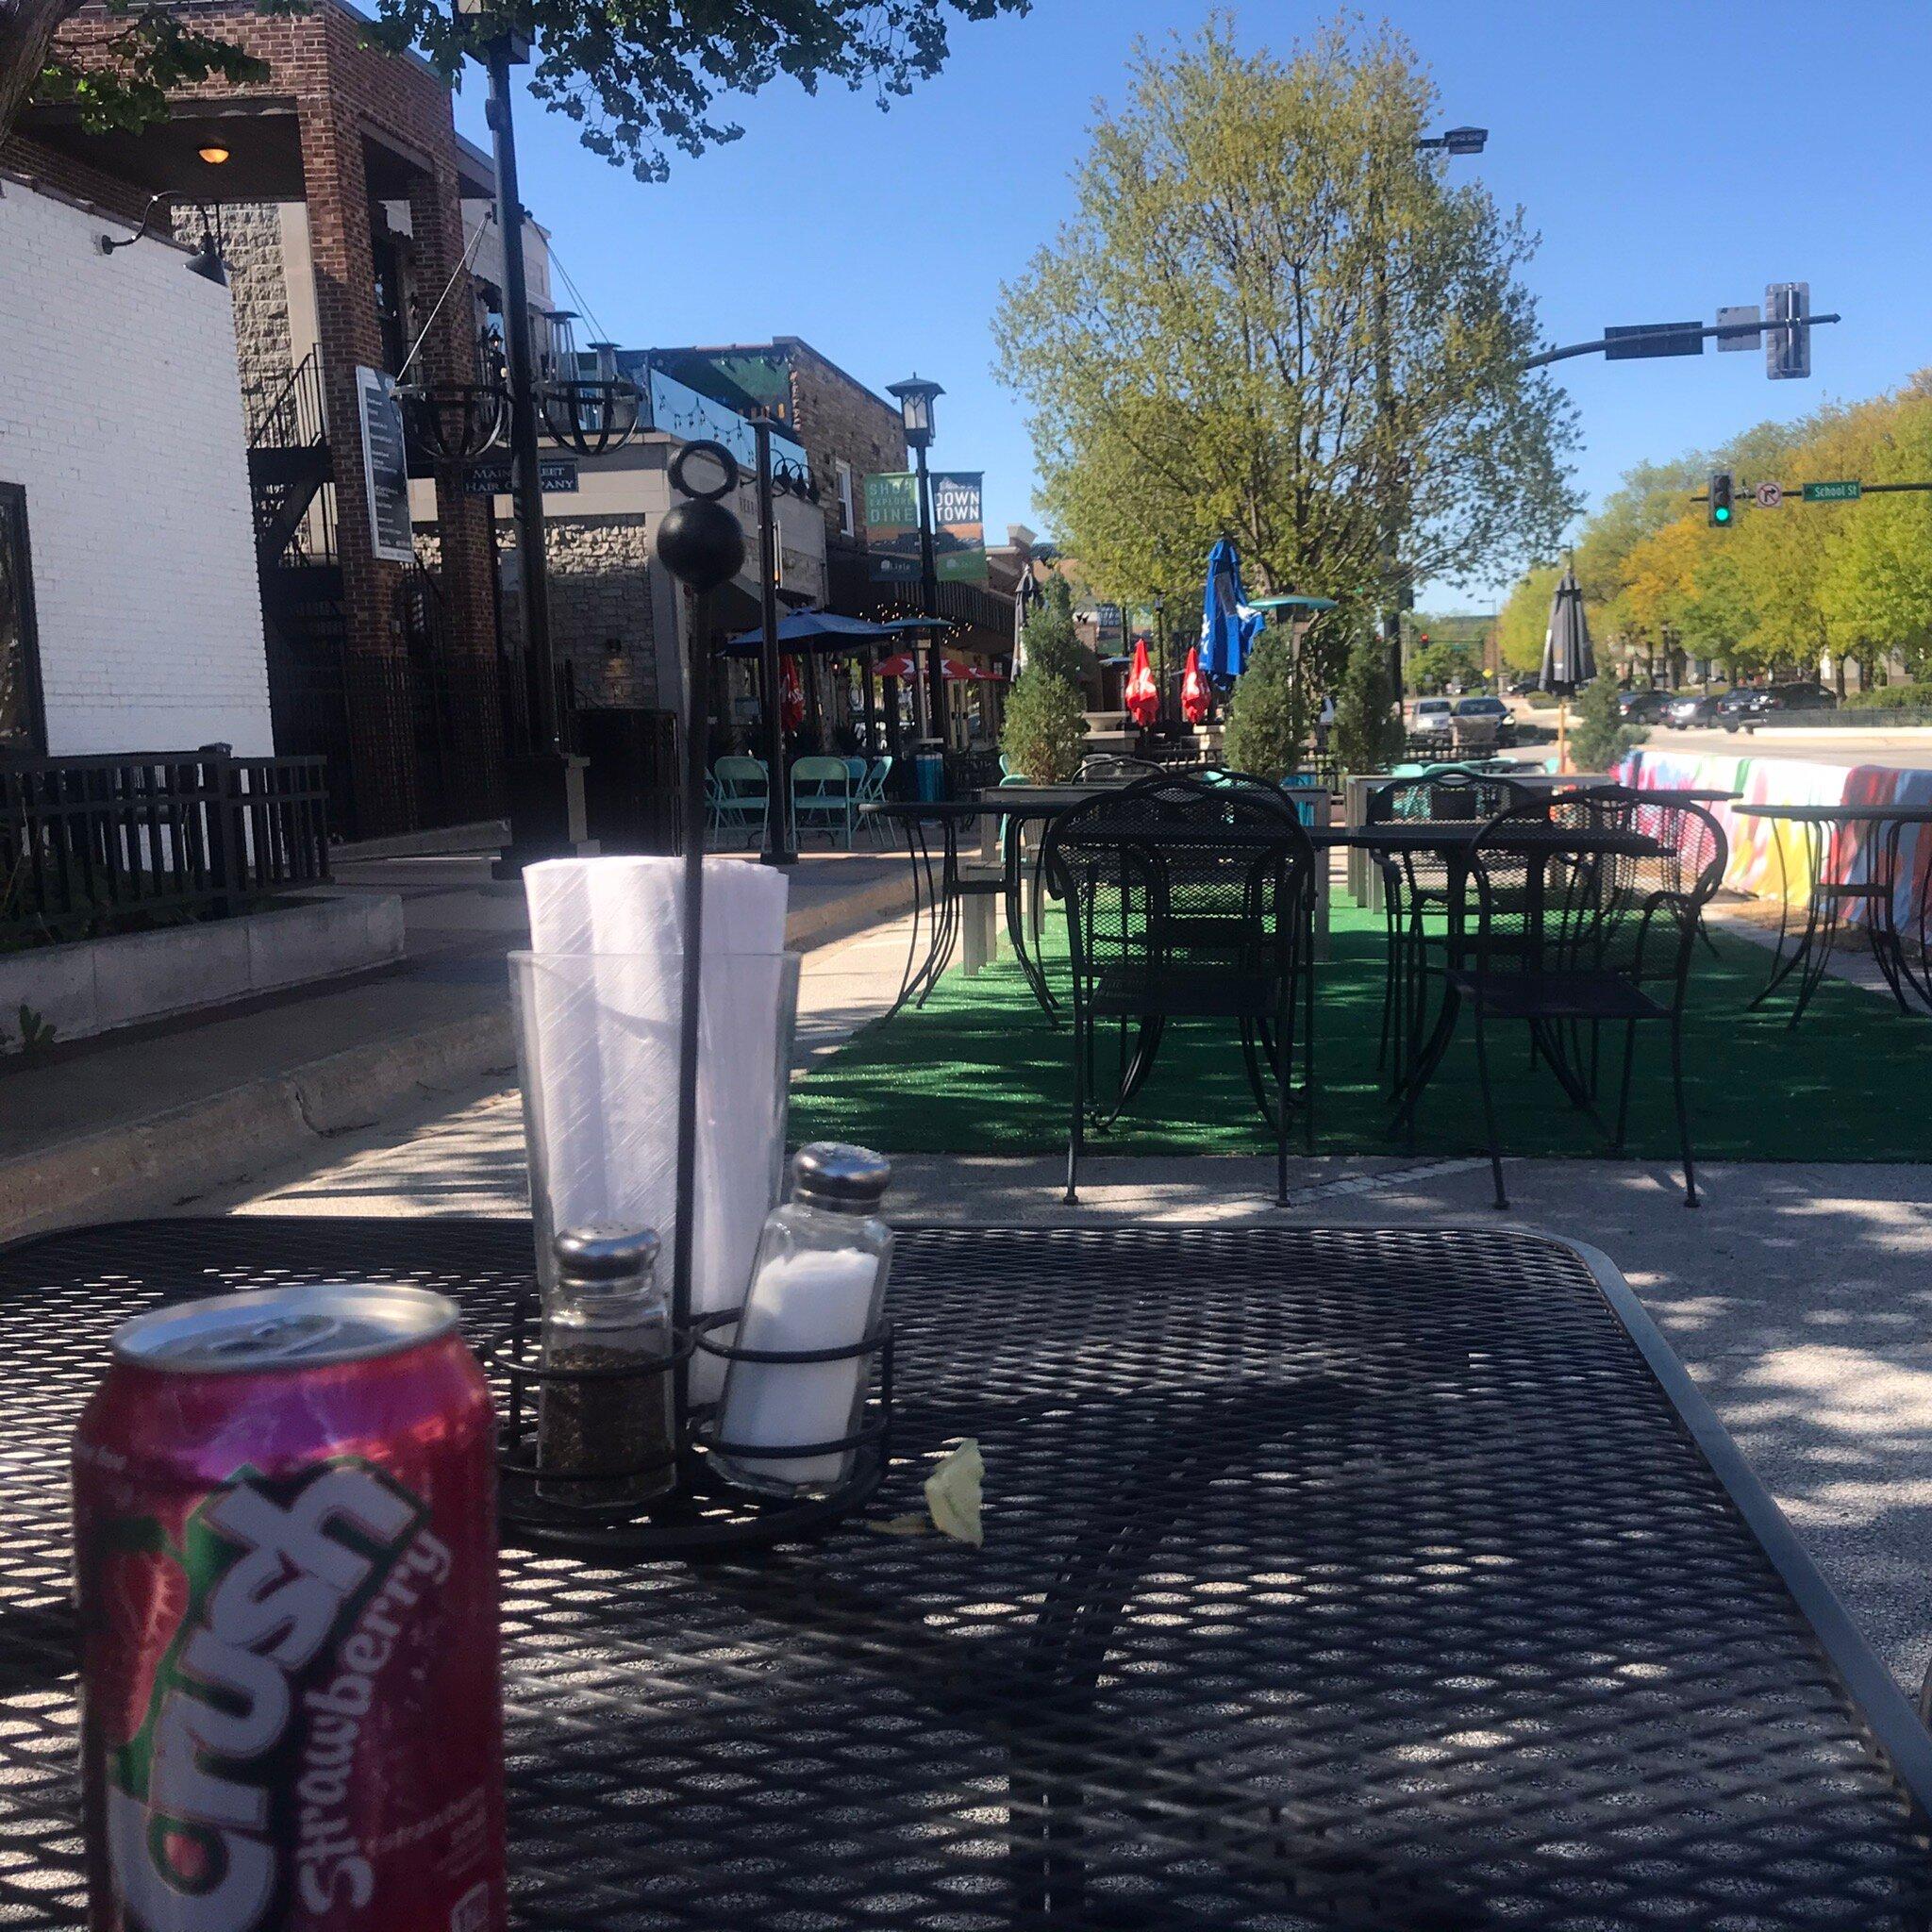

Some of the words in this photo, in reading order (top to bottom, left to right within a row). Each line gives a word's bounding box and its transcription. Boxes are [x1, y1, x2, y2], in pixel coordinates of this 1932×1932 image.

[465, 481, 500, 491] HAIR
[869, 479, 912, 496] SHOP
[1814, 485, 1845, 497] School
[1847, 484, 1857, 496] St
[869, 496, 912, 508] EXPLORE
[936, 491, 980, 507] DOWN
[870, 508, 914, 524] DINE
[936, 506, 980, 522] TOWN
[296, 1529, 451, 1914] Strawberry
